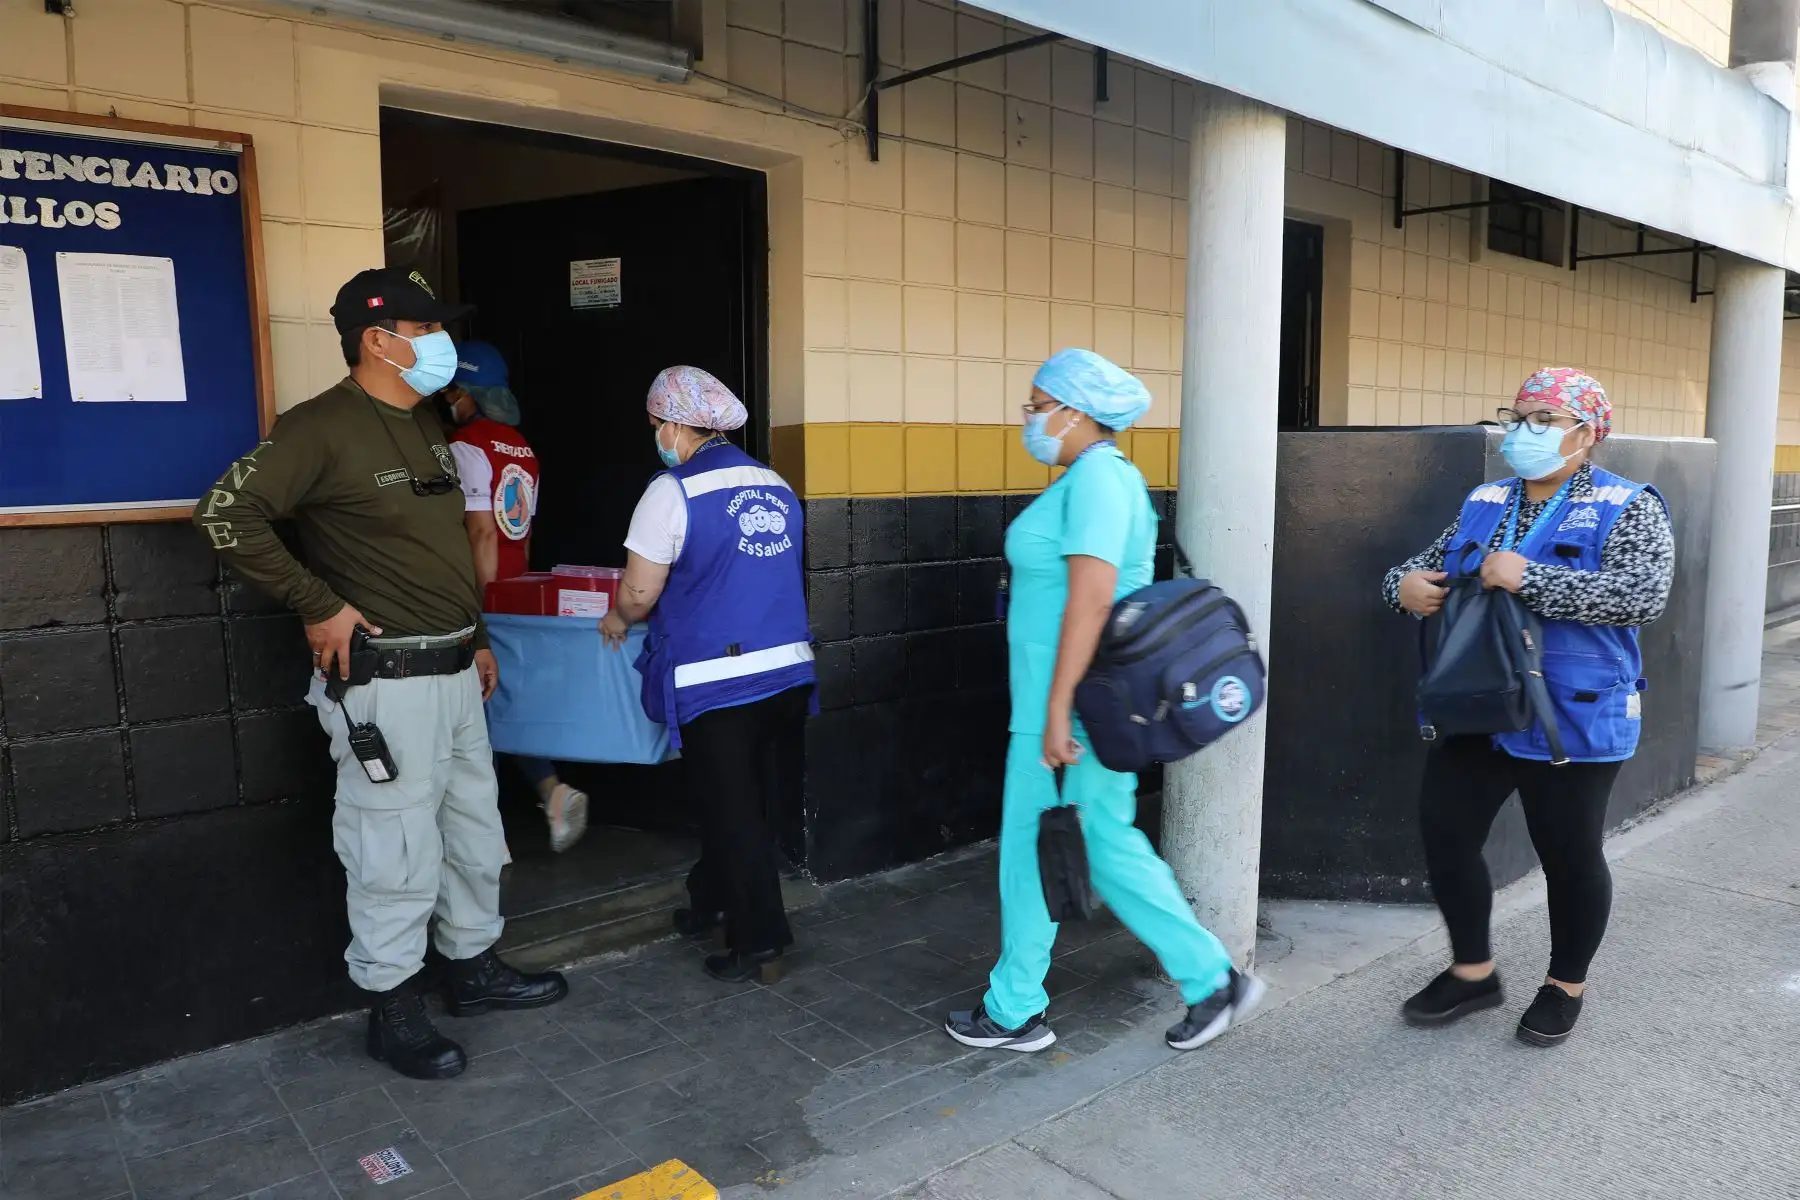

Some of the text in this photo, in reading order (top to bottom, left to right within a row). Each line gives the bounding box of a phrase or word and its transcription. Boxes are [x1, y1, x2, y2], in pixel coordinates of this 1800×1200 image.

[0, 149, 238, 195] TENCIARIO
[572, 279, 590, 287] LOCAL
[202, 441, 274, 549] INPE
[727, 489, 764, 517] HOSPITAL
[738, 534, 793, 557] EsSalud
